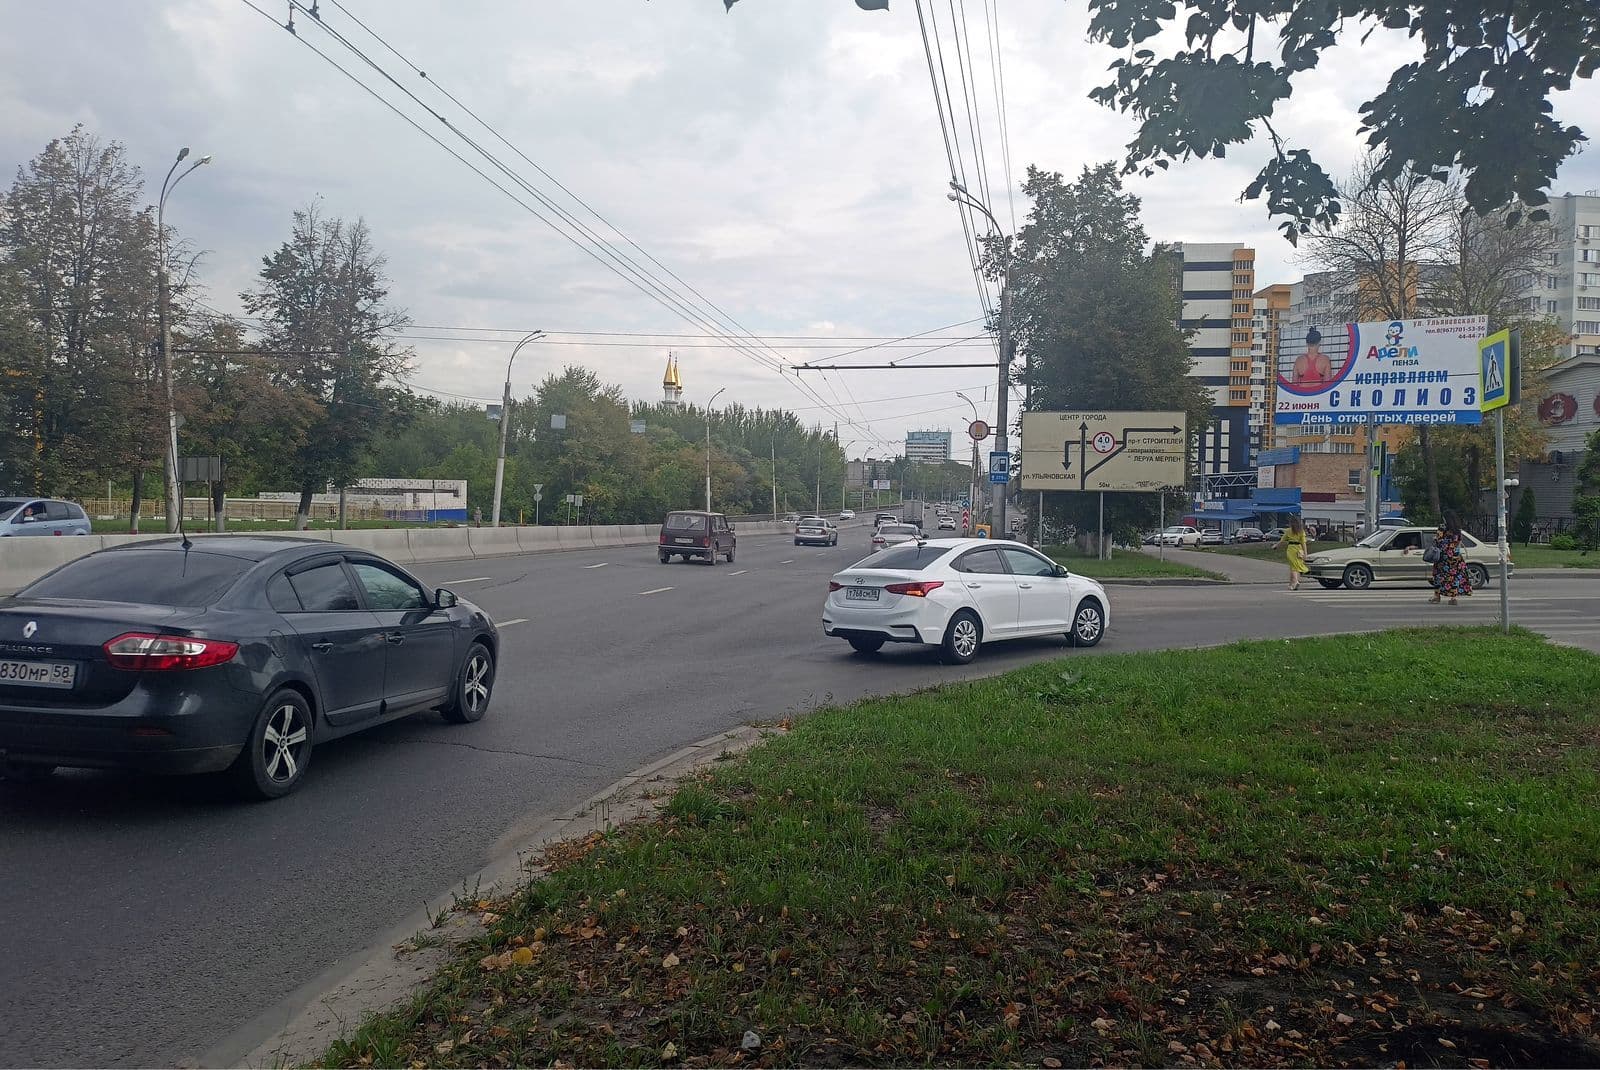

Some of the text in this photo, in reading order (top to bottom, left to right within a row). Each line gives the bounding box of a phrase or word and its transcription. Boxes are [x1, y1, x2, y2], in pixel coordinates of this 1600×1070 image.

[1355, 370, 1448, 386] исправляем
[1329, 387, 1475, 407] СКОЛИОЗ
[1278, 401, 1320, 410] 22 июня
[1301, 412, 1332, 425] День
[1405, 410, 1456, 425] дверей
[1142, 437, 1184, 445] СТРОИТЕЛЕЙ
[53, 665, 70, 678] 58
